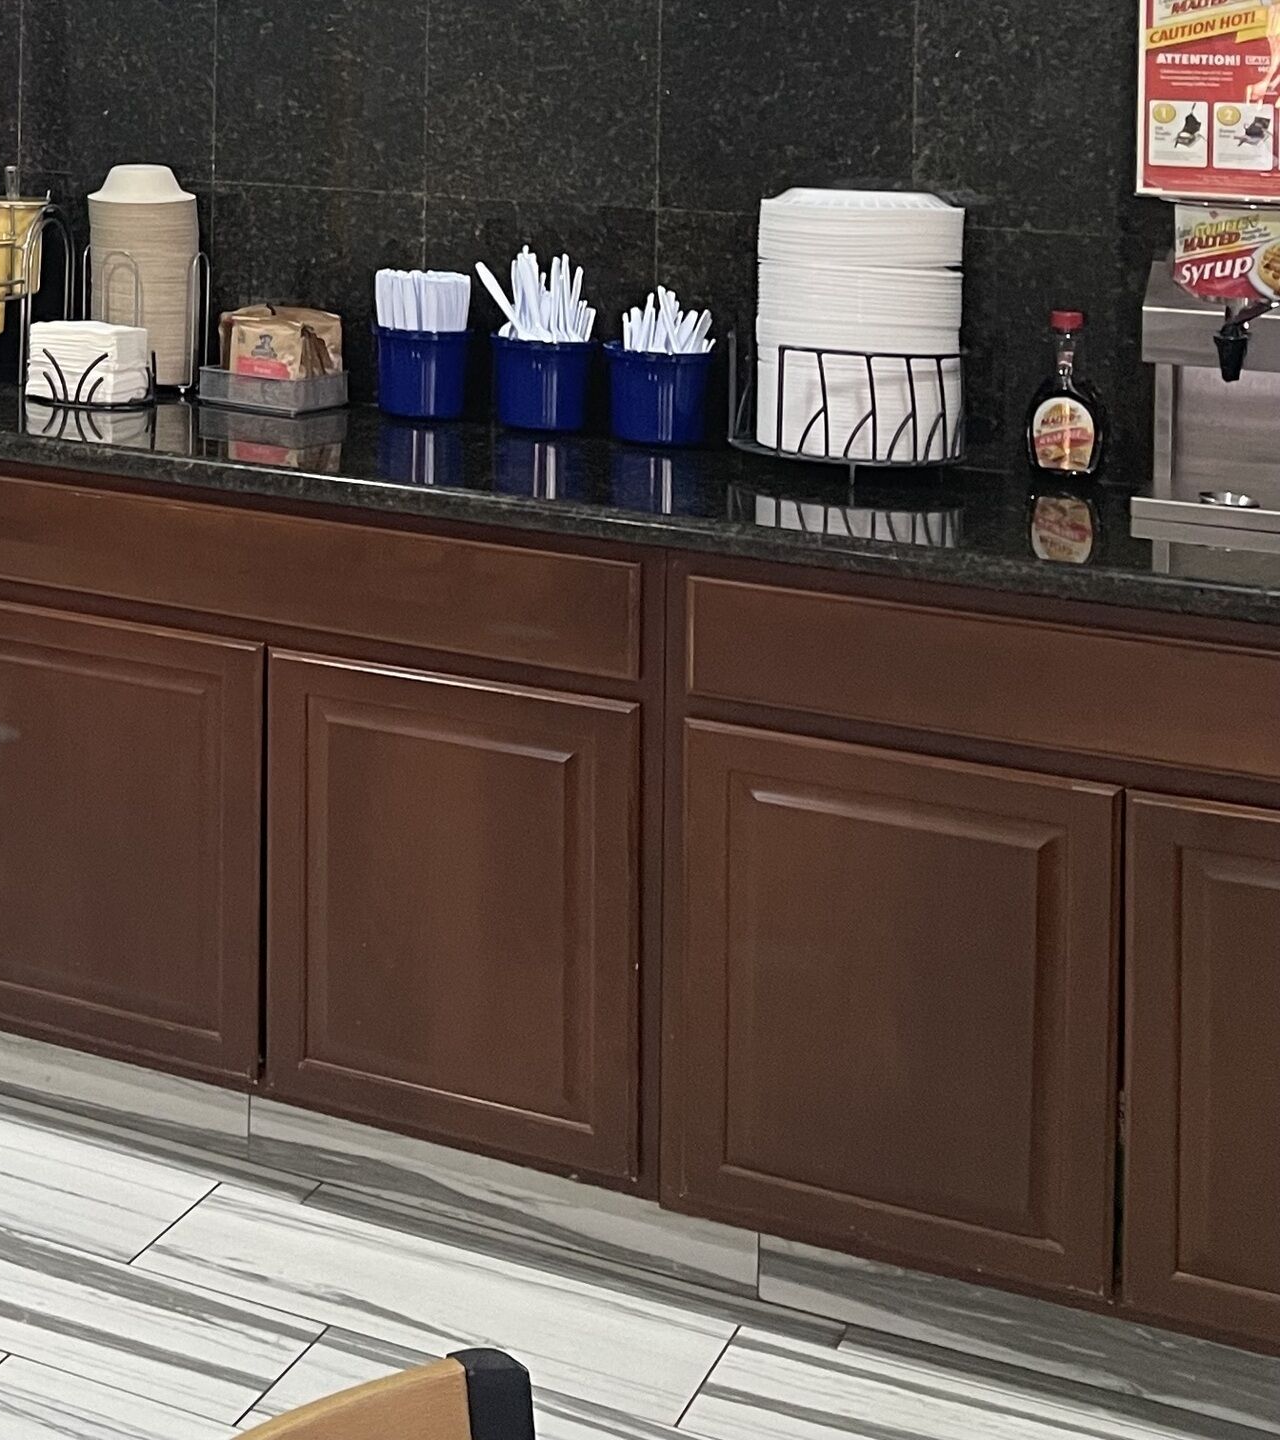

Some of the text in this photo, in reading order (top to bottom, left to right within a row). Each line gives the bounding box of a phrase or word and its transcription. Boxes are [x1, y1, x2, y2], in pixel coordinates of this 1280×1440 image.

[1149, 11, 1256, 44] CAUTION HOT!
[1156, 53, 1241, 66] ATTENTION!
[1160, 107, 1167, 119] 1
[1183, 231, 1240, 253] MALTED
[1180, 256, 1254, 286] Syrup
